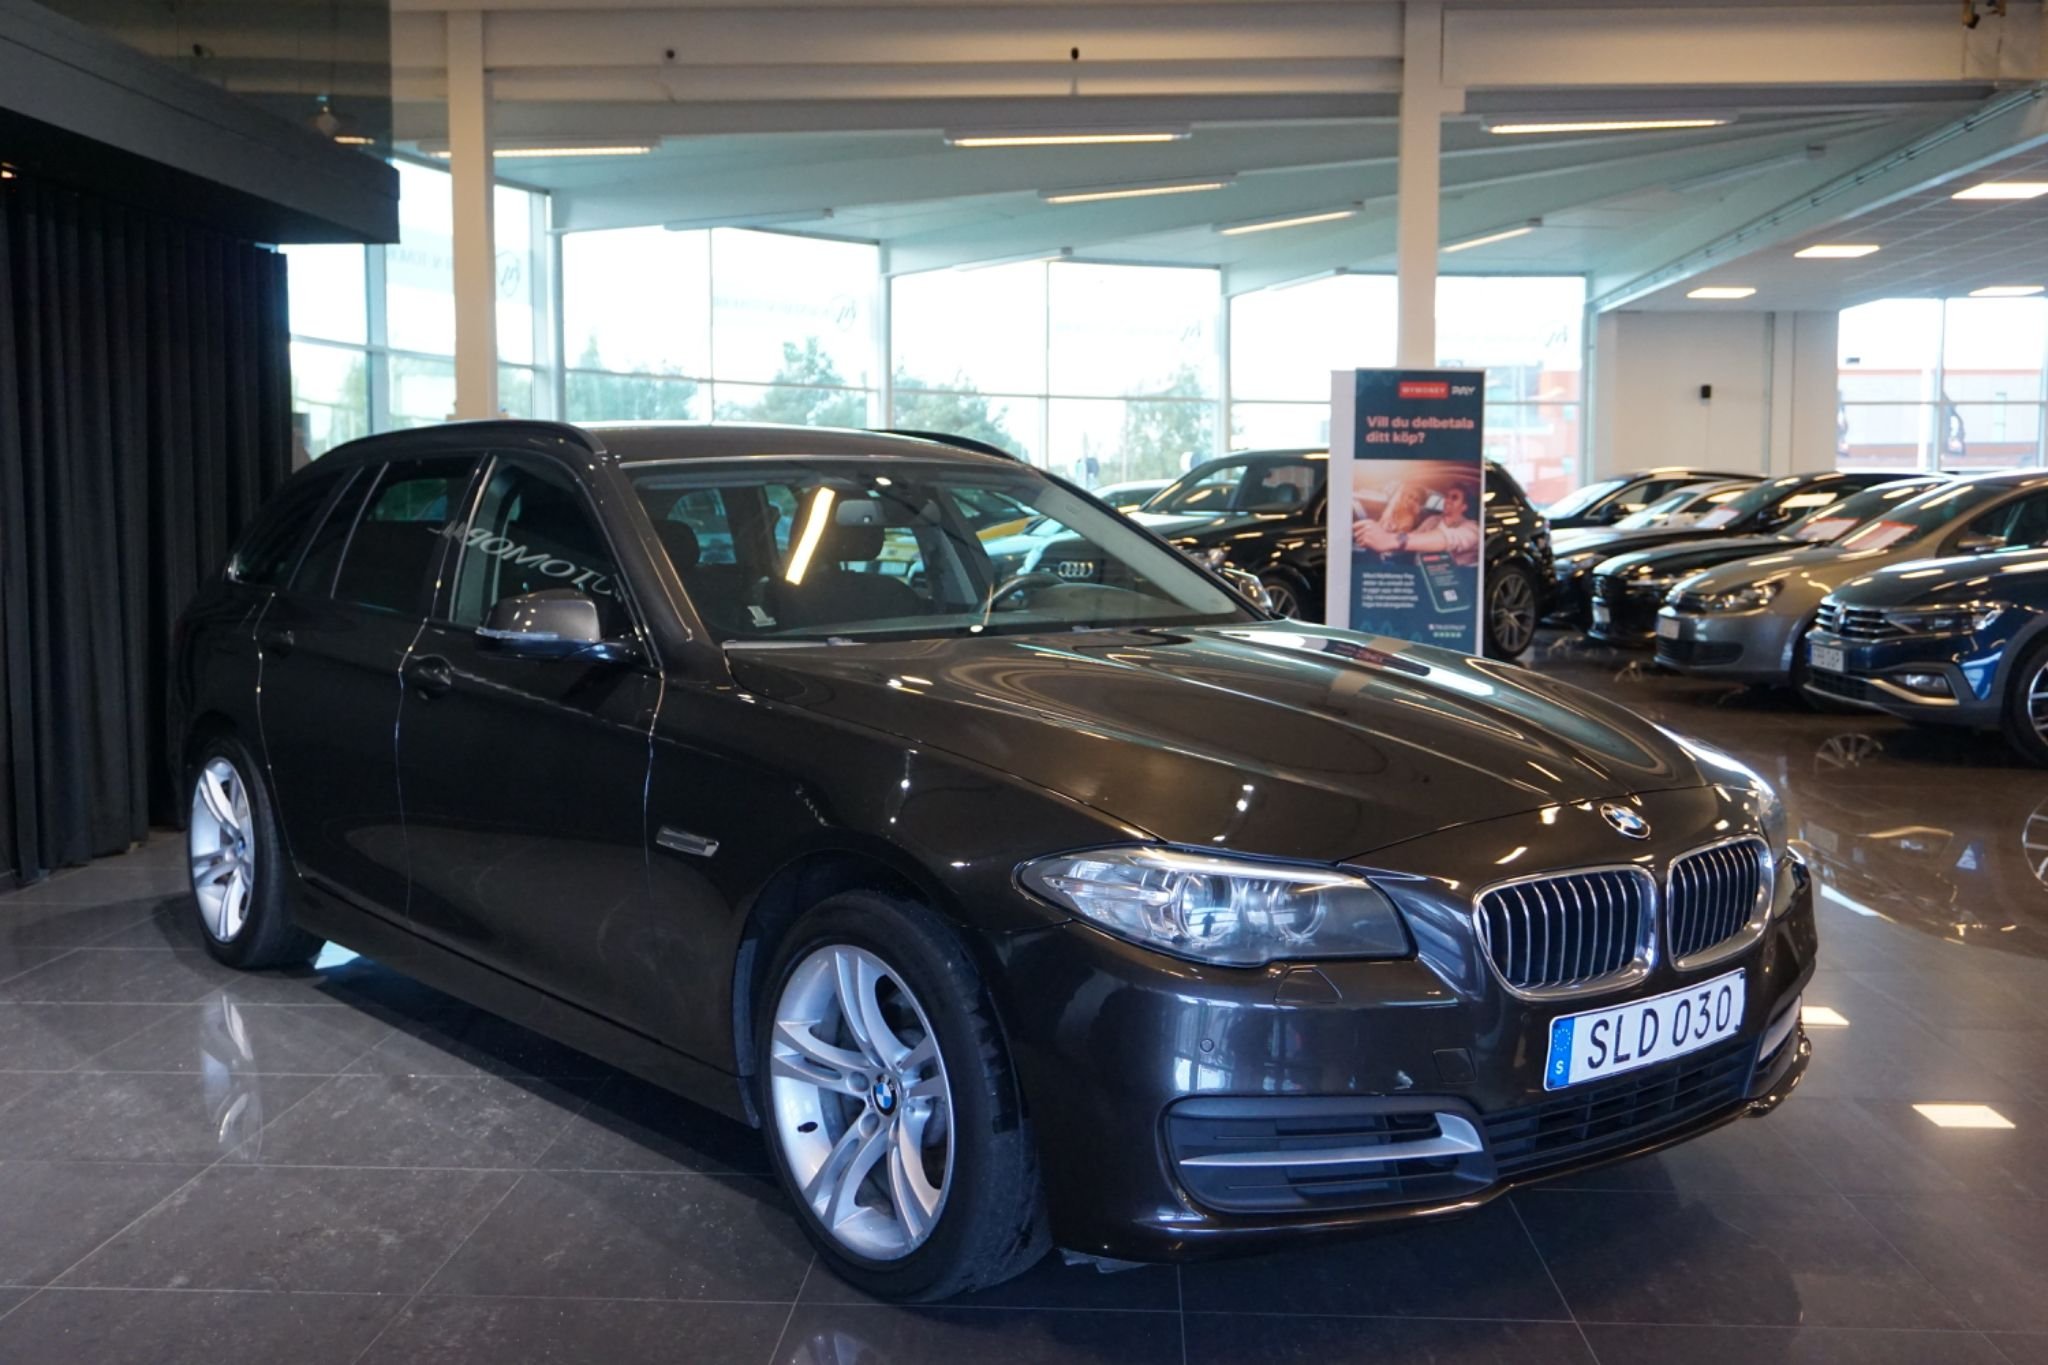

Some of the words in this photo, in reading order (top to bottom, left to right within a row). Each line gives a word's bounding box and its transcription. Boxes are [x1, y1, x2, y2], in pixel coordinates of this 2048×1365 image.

[1366, 415, 1389, 428] Vill
[1391, 416, 1409, 428] du
[1412, 416, 1474, 429] delbetala
[1365, 431, 1389, 443] ditt
[1392, 431, 1425, 446] köp?
[1588, 1008, 1659, 1069] SLD
[1672, 985, 1732, 1047] 030
[1555, 1060, 1564, 1075] S
